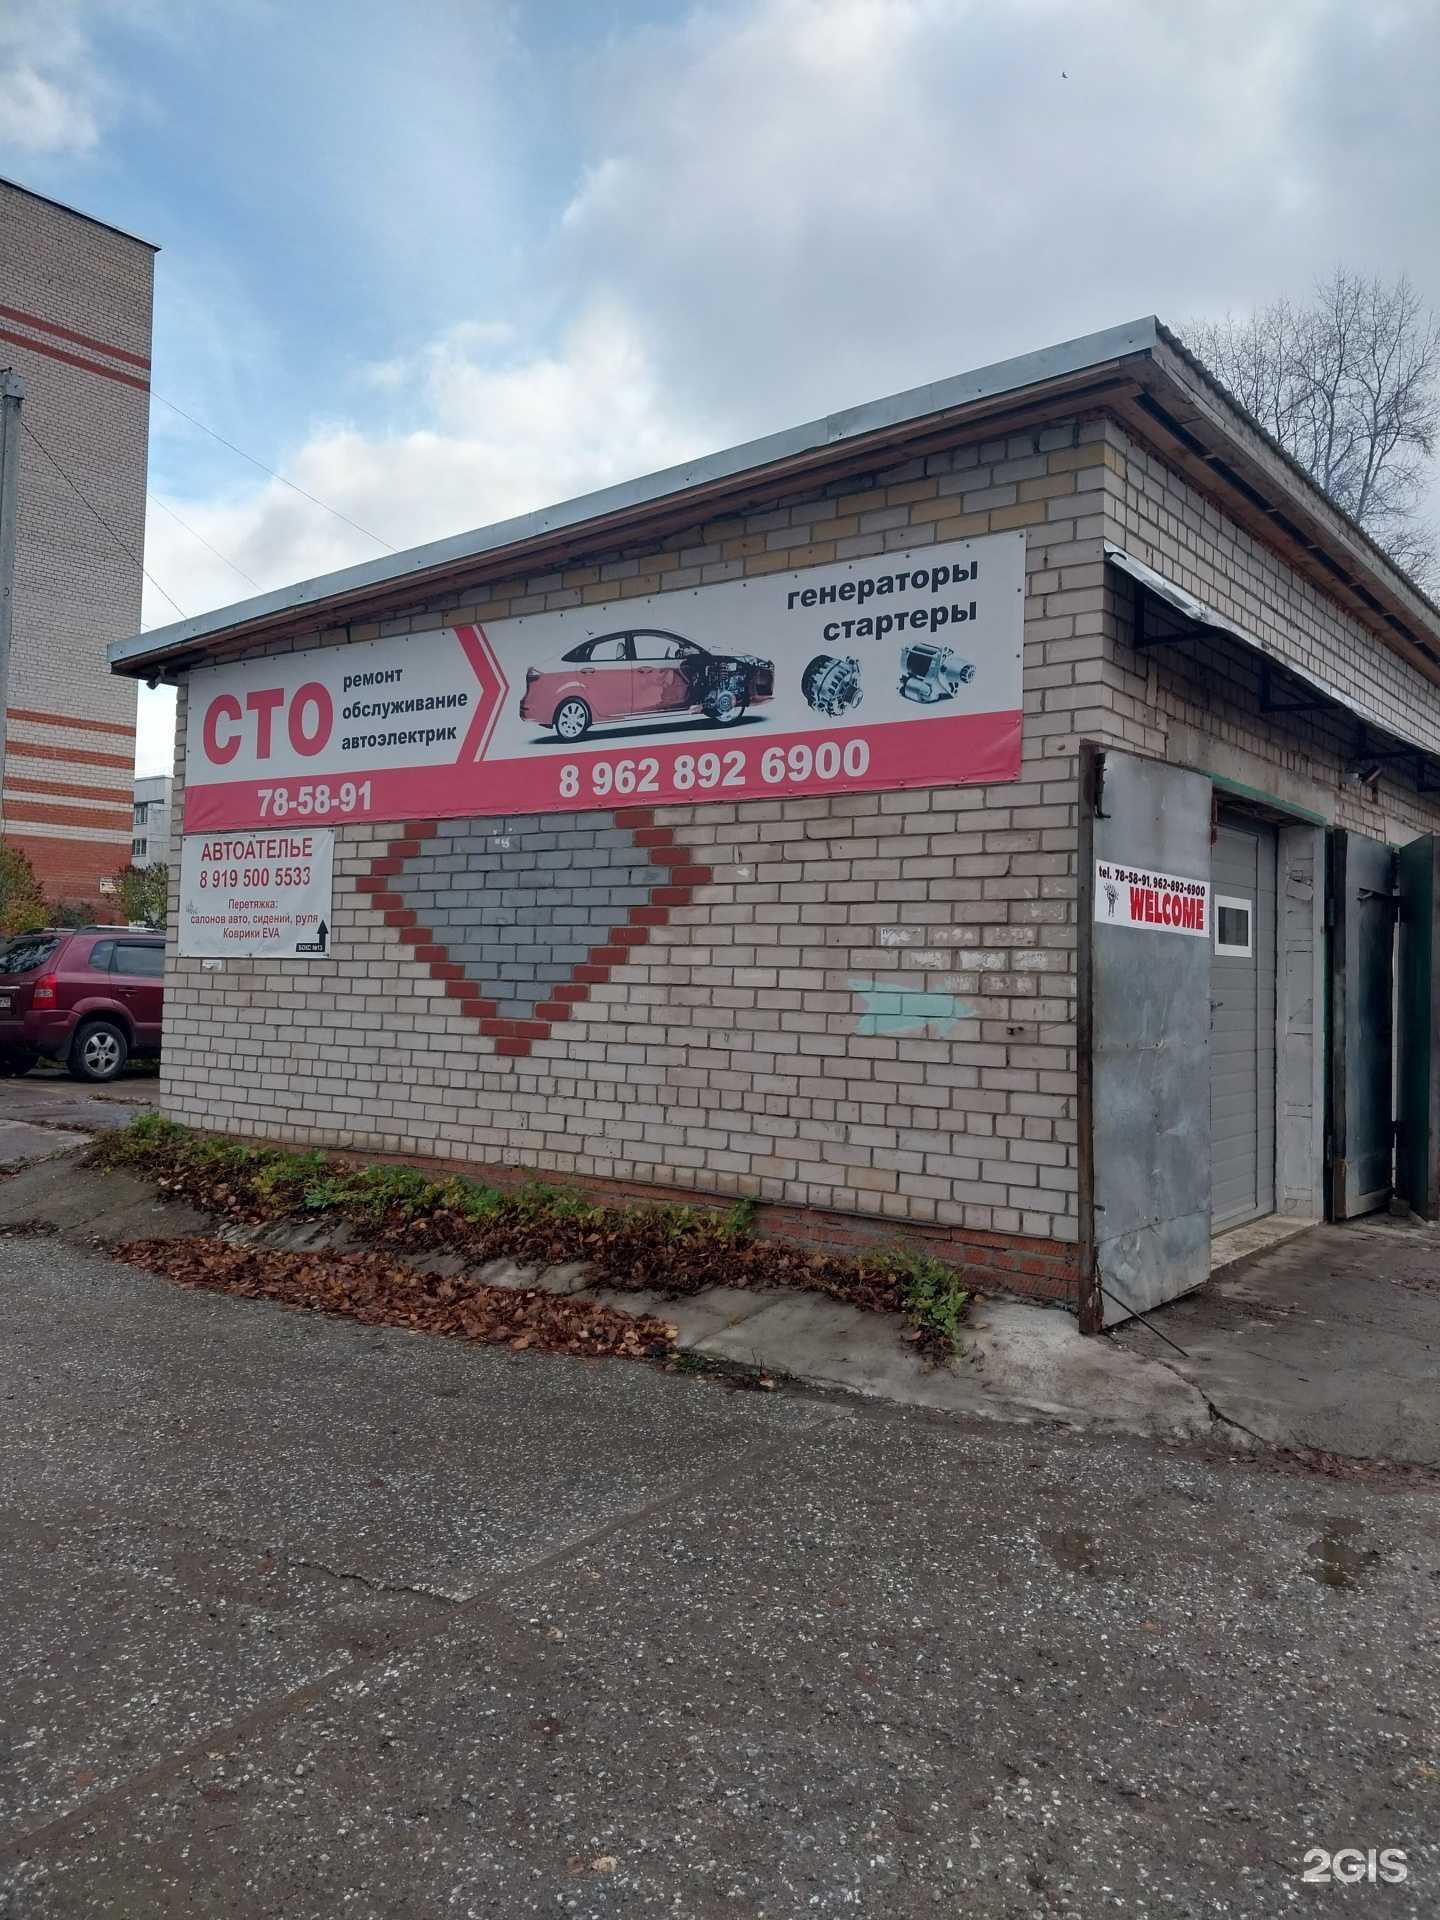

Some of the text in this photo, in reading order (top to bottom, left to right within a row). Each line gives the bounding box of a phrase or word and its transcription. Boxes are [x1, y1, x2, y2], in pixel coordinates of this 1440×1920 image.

[787, 560, 978, 610] генераторы
[823, 601, 977, 641] стартеры
[343, 668, 403, 692] ремонт
[342, 692, 468, 719] обслуживание
[203, 681, 333, 765] СТО
[341, 726, 457, 750] автоэлектрик
[559, 739, 870, 798] 8 962 892 6900
[257, 781, 372, 817] 78-58-91
[201, 837, 313, 861] АВТОАТЕЛЬЕ
[199, 866, 311, 888] 8 919 500 5533
[1099, 865, 1112, 880] tel.
[1153, 876, 1206, 897] 962-892-6900
[228, 898, 279, 909] Перетяжка:
[1129, 886, 1204, 930] WELCOME
[190, 914, 226, 924] салонов
[295, 913, 318, 926] руля
[223, 927, 280, 939] Коврики EVA
